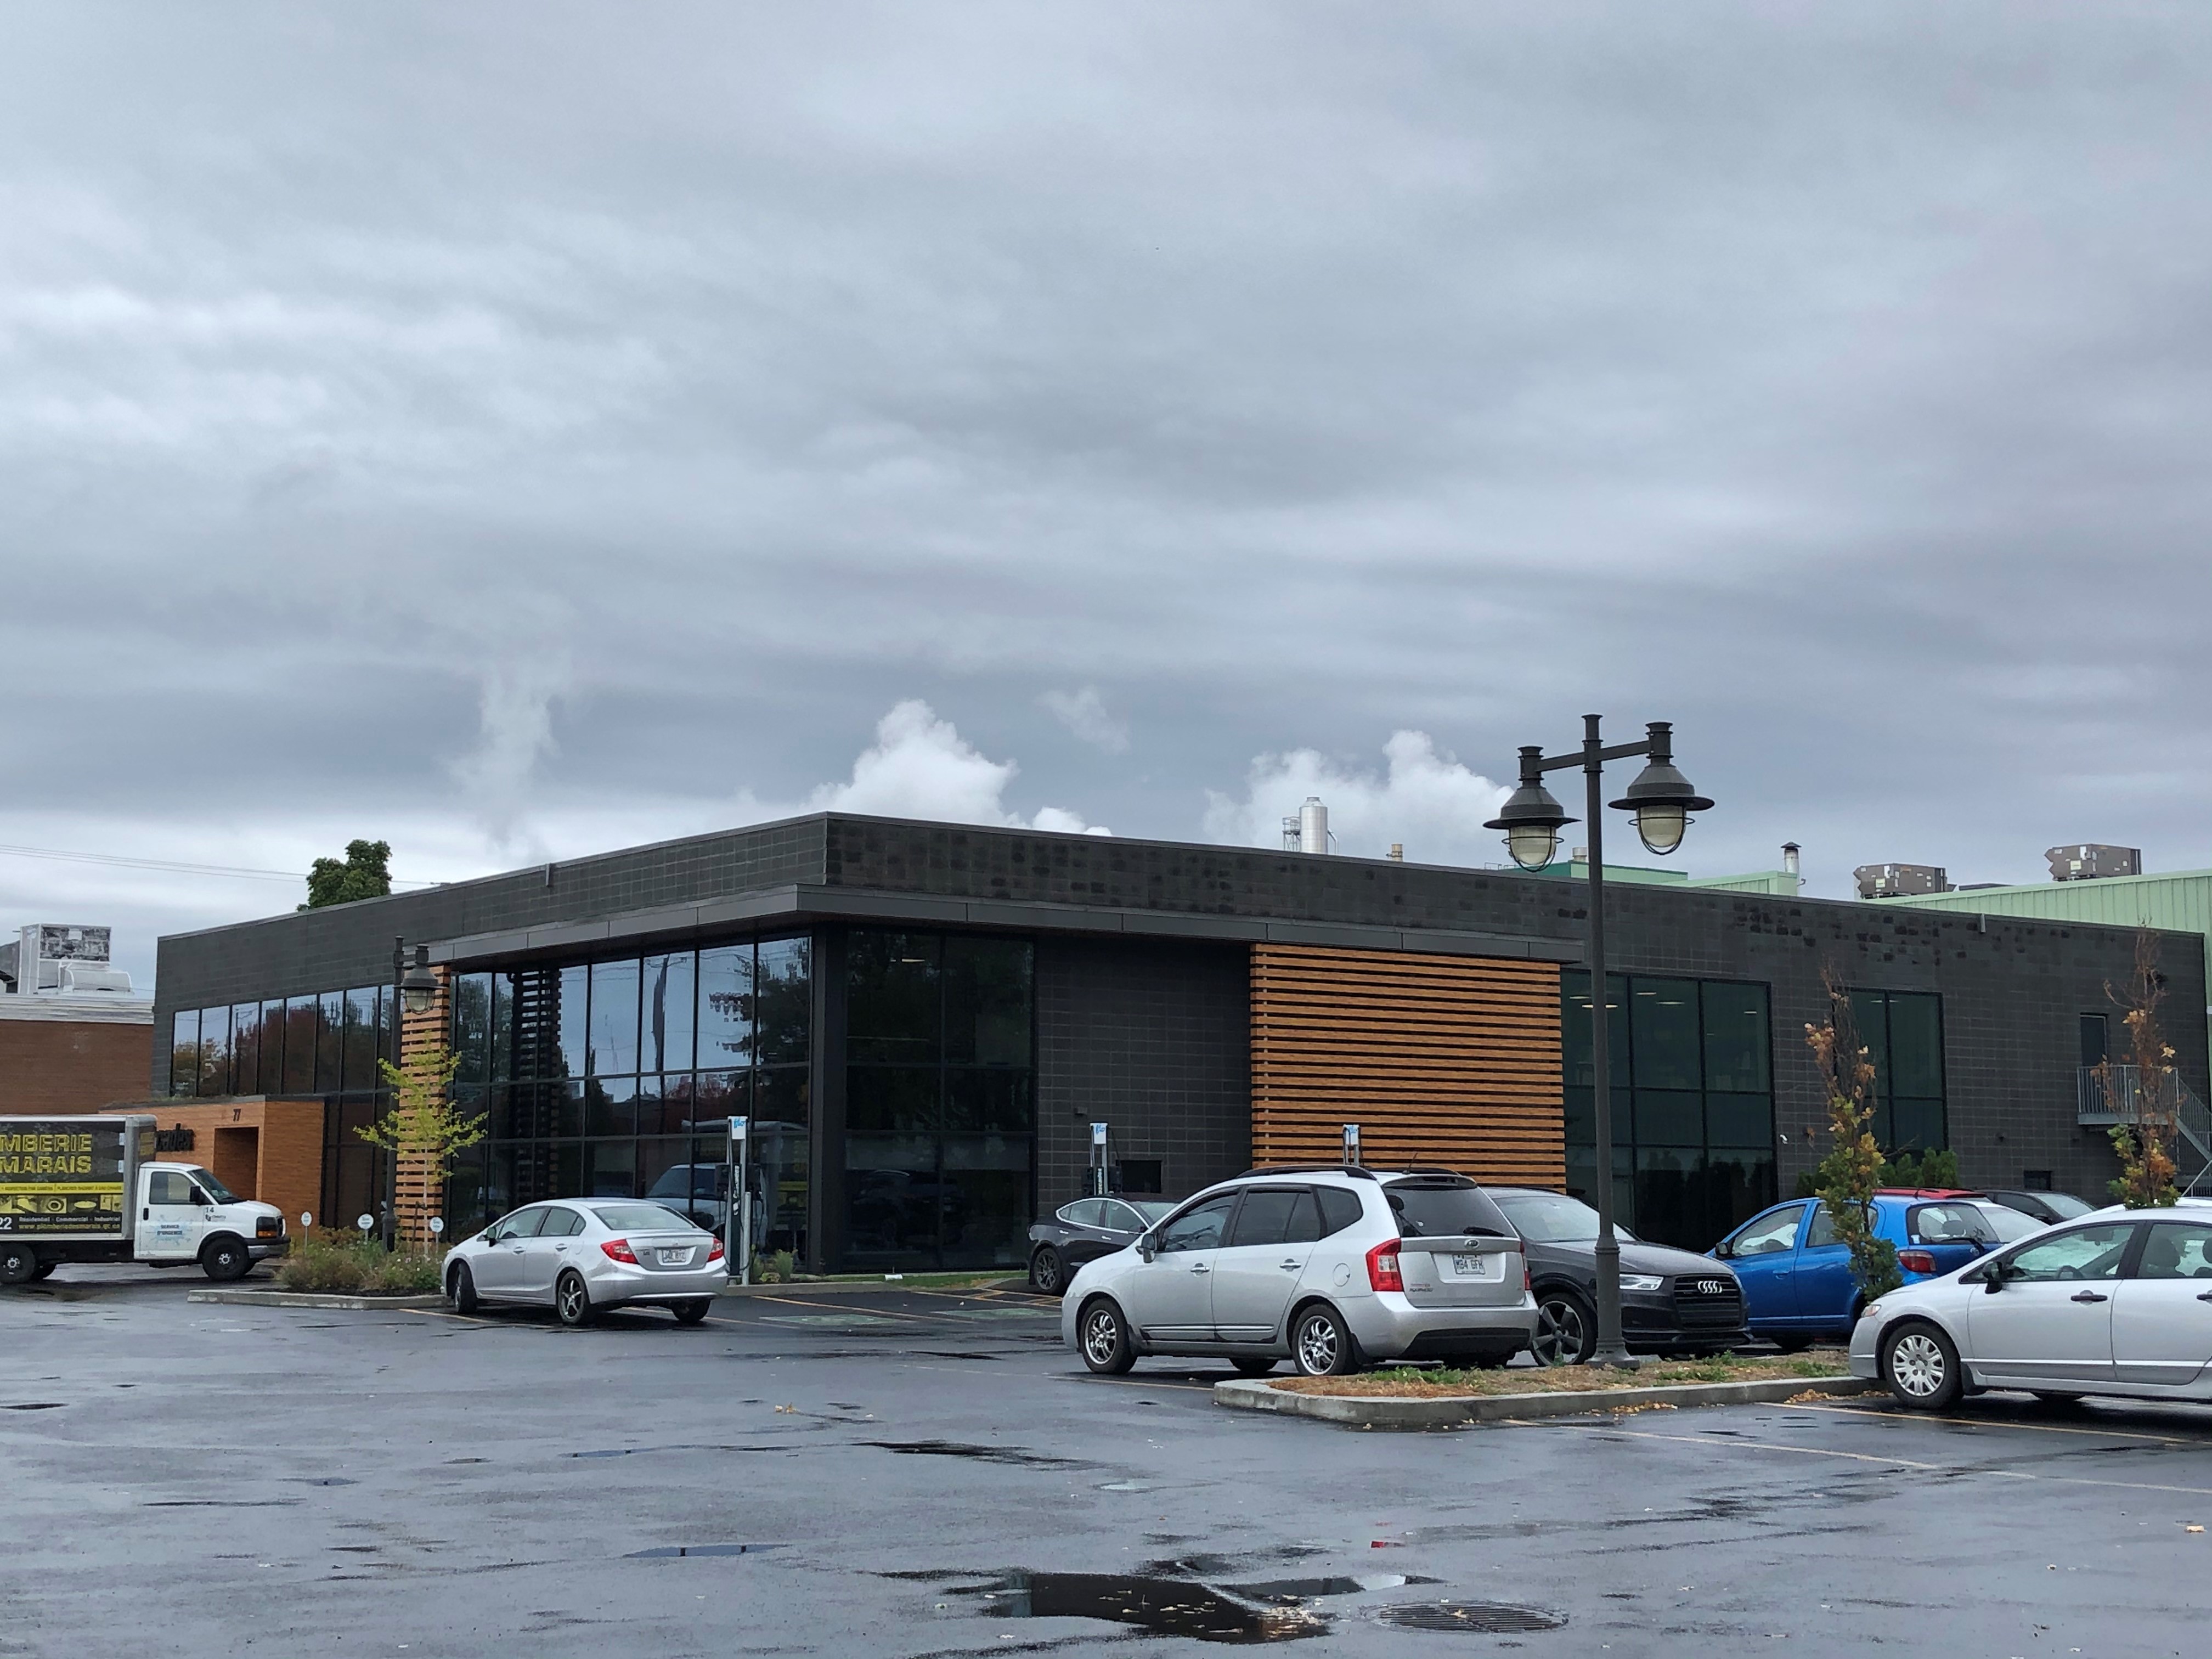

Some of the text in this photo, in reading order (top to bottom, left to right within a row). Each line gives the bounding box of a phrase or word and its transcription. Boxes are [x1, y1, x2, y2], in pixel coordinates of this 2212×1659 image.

[233, 1109, 241, 1121] 77
[0, 1134, 92, 1152] MBERIE
[0, 1156, 91, 1173] MARAIS
